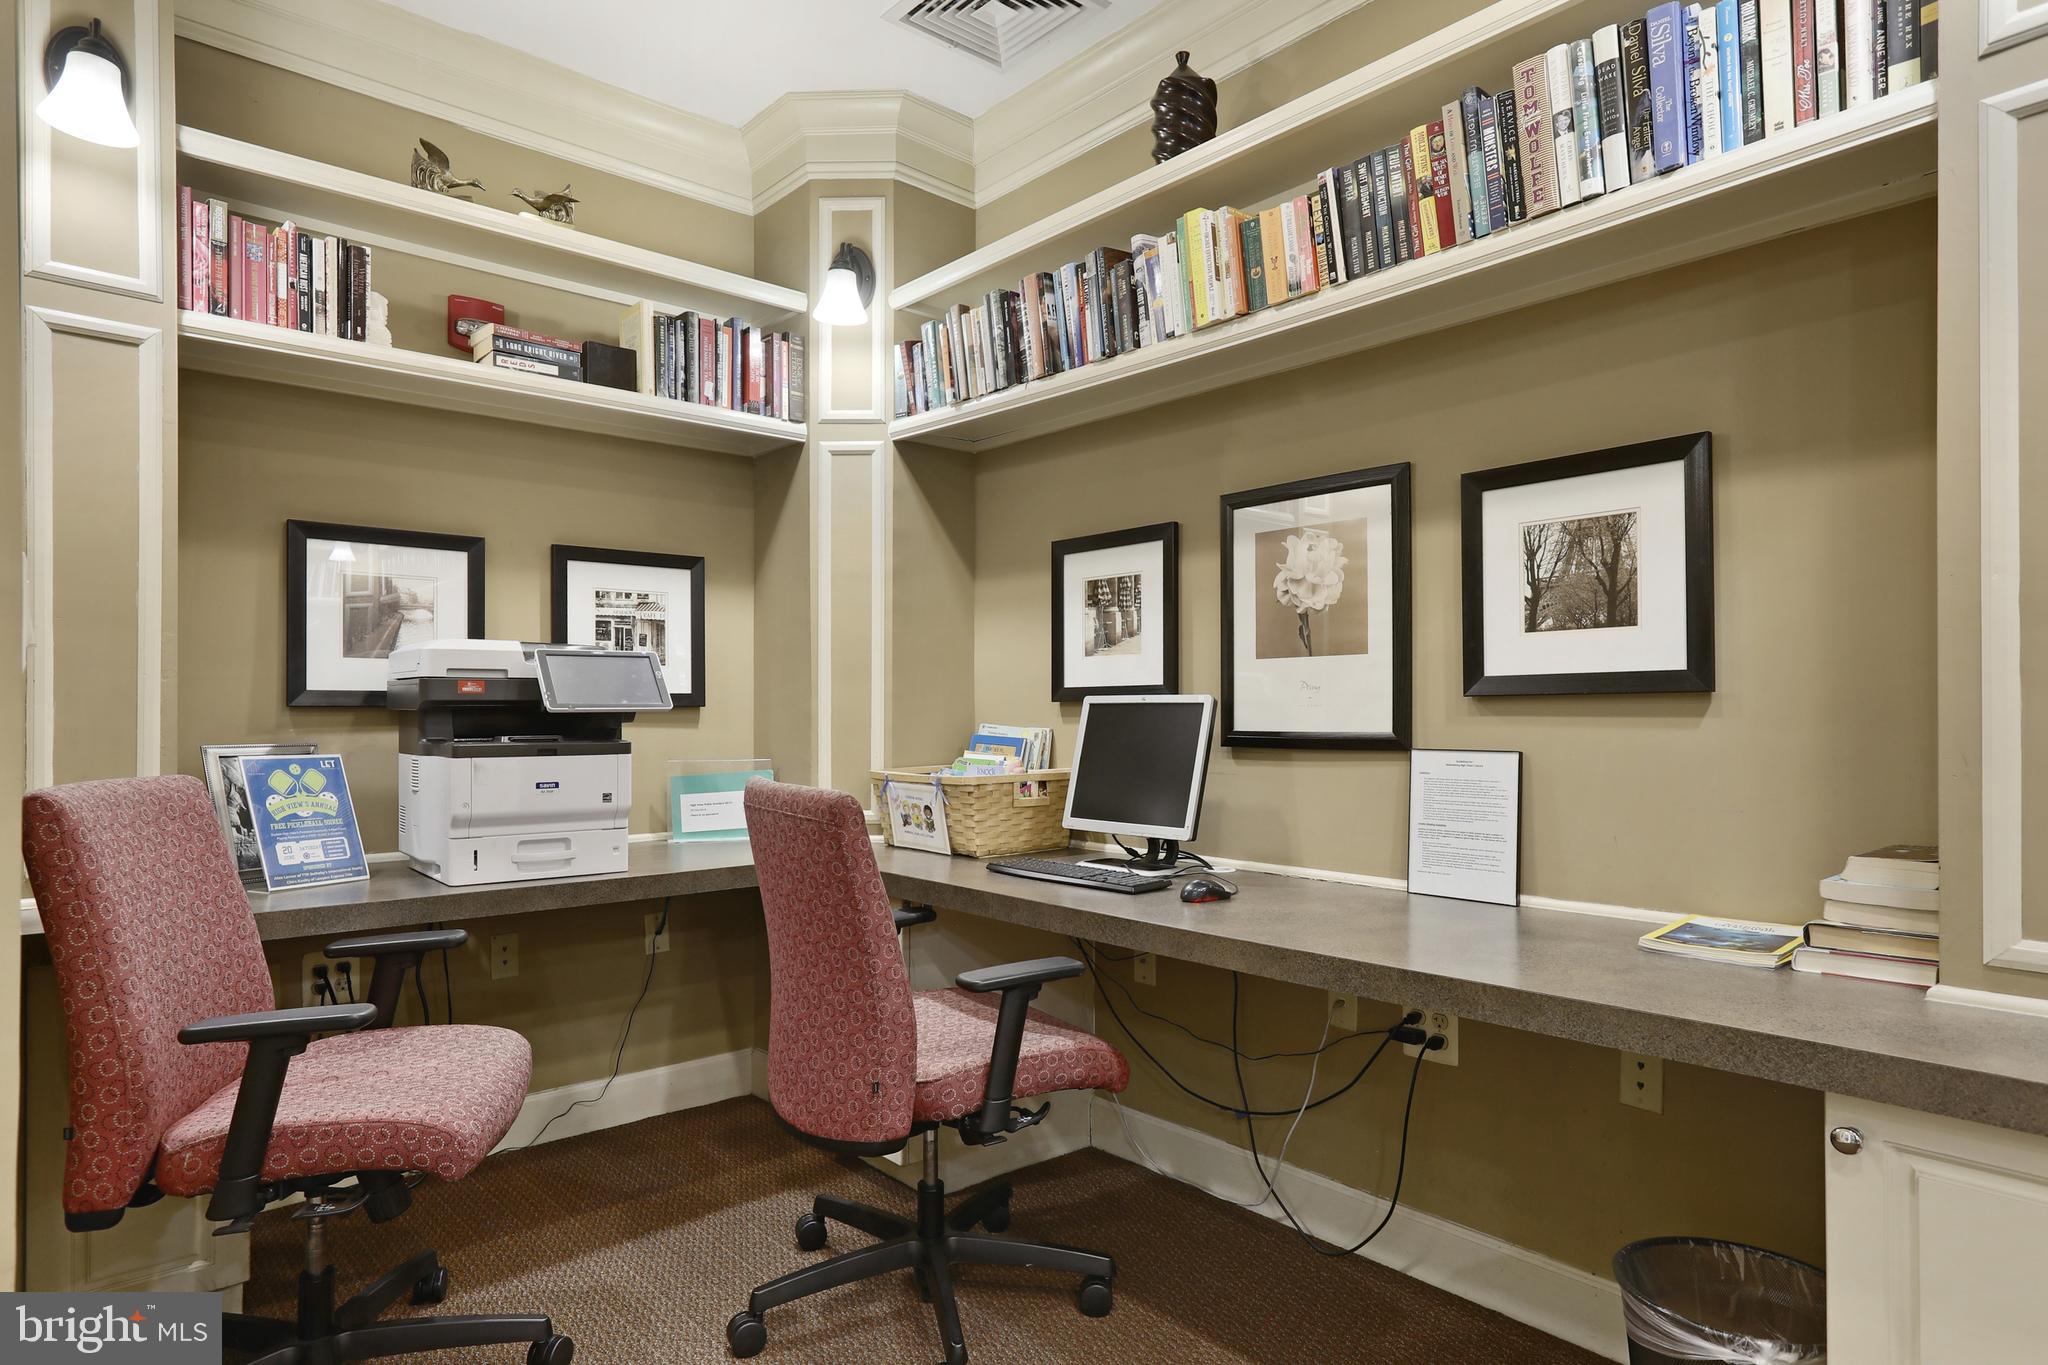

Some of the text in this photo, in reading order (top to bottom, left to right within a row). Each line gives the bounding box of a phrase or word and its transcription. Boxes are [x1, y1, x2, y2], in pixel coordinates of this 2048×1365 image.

[1650, 23, 1672, 67] Silva
[1685, 27, 1699, 64] Beyond
[1875, 30, 1885, 56] ANNE
[1904, 25, 1912, 48] REX
[1598, 64, 1615, 75] DEAD
[1599, 72, 1616, 82] WAKE
[1627, 23, 1649, 97] Daniel Silva
[1746, 60, 1754, 89] MICHAEL
[1797, 58, 1811, 79] Poe
[1877, 59, 1886, 89] TYLER
[1580, 91, 1589, 108] Little
[1654, 86, 1665, 122] Collector
[1688, 77, 1701, 114] Broken
[1504, 99, 1516, 142] SERVICE
[1521, 68, 1544, 204] TOM WOLFE
[1582, 111, 1590, 129] Fires
[1688, 114, 1703, 155] Window
[1417, 131, 1426, 153] MOLLY
[1481, 126, 1500, 171] MONSTERS
[1580, 130, 1596, 178] Everywhere
[1630, 125, 1642, 151] Angel
[1387, 149, 1404, 198] TRUE INTENT
[1404, 157, 1412, 171] Girl
[1419, 154, 1428, 173] IVINS
[1342, 168, 1354, 201] JUST PLEA
[1356, 162, 1370, 218] SWIFT JUDGMENT
[1372, 155, 1388, 216] BLIND CONVICTION
[1472, 199, 1481, 223] ALICE
[1479, 194, 1488, 224] FEENEY
[1313, 209, 1330, 288] EVE JOHANSEN
[1349, 236, 1361, 273] MICHAEL STAGG
[1364, 230, 1375, 268] MICHAEL STAGG
[1380, 225, 1392, 264] MICHAEL STAGG
[1396, 219, 1409, 258] MICHAEL STAGG
[298, 252, 307, 292] AMERICAN RUST
[1135, 287, 1145, 305] ELIOT
[1100, 303, 1108, 326] DONNA
[505, 341, 567, 360] LONG BRIGHT RIVER
